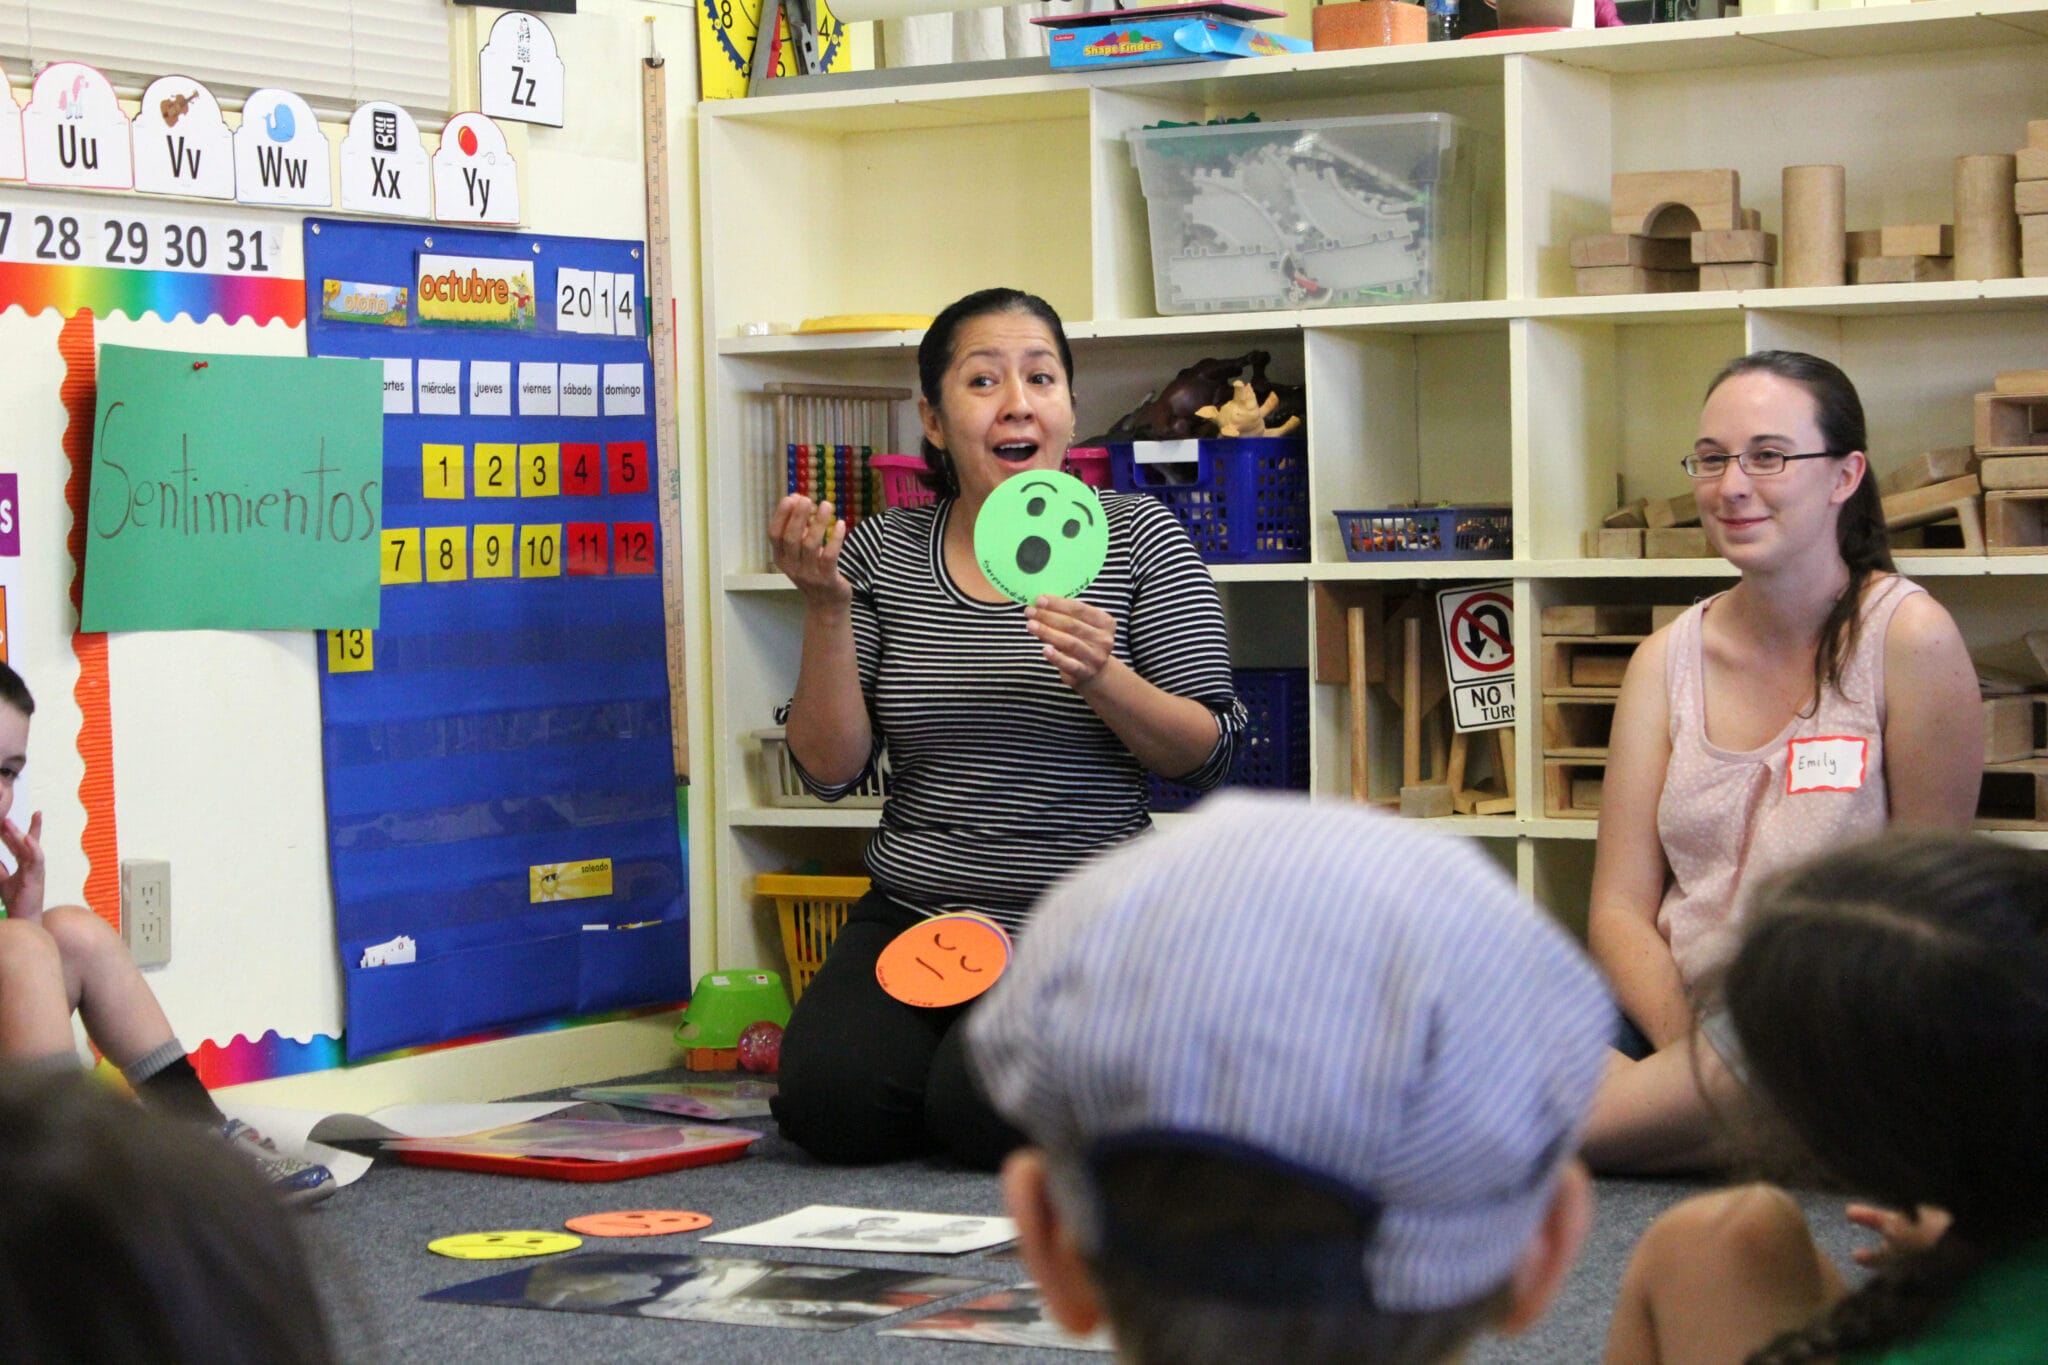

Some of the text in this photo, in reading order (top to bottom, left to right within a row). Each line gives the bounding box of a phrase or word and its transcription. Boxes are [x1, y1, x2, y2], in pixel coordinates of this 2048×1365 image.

[721, 0, 733, 29] 8
[818, 14, 830, 41] 4
[1084, 41, 1163, 57] Shape Finders
[511, 65, 536, 107] Zz
[58, 124, 98, 169] Uu
[167, 135, 201, 180] Vv
[257, 145, 307, 189] Ww
[371, 156, 401, 199] Xx
[463, 167, 490, 218] Yy
[0, 211, 268, 272] 7 28 29 30 31
[344, 291, 388, 315] otoño
[419, 267, 633, 319] octubre 2014
[383, 380, 641, 398] artes miércoles jueves viernes sábado domingo
[94, 401, 378, 543] Sentimientos
[439, 453, 635, 487] 1 2 3 4 5
[391, 532, 647, 571] 7 8 9 10 11 12
[335, 629, 364, 659] 13
[1471, 686, 1501, 708] NO
[1798, 752, 1837, 775] Emily
